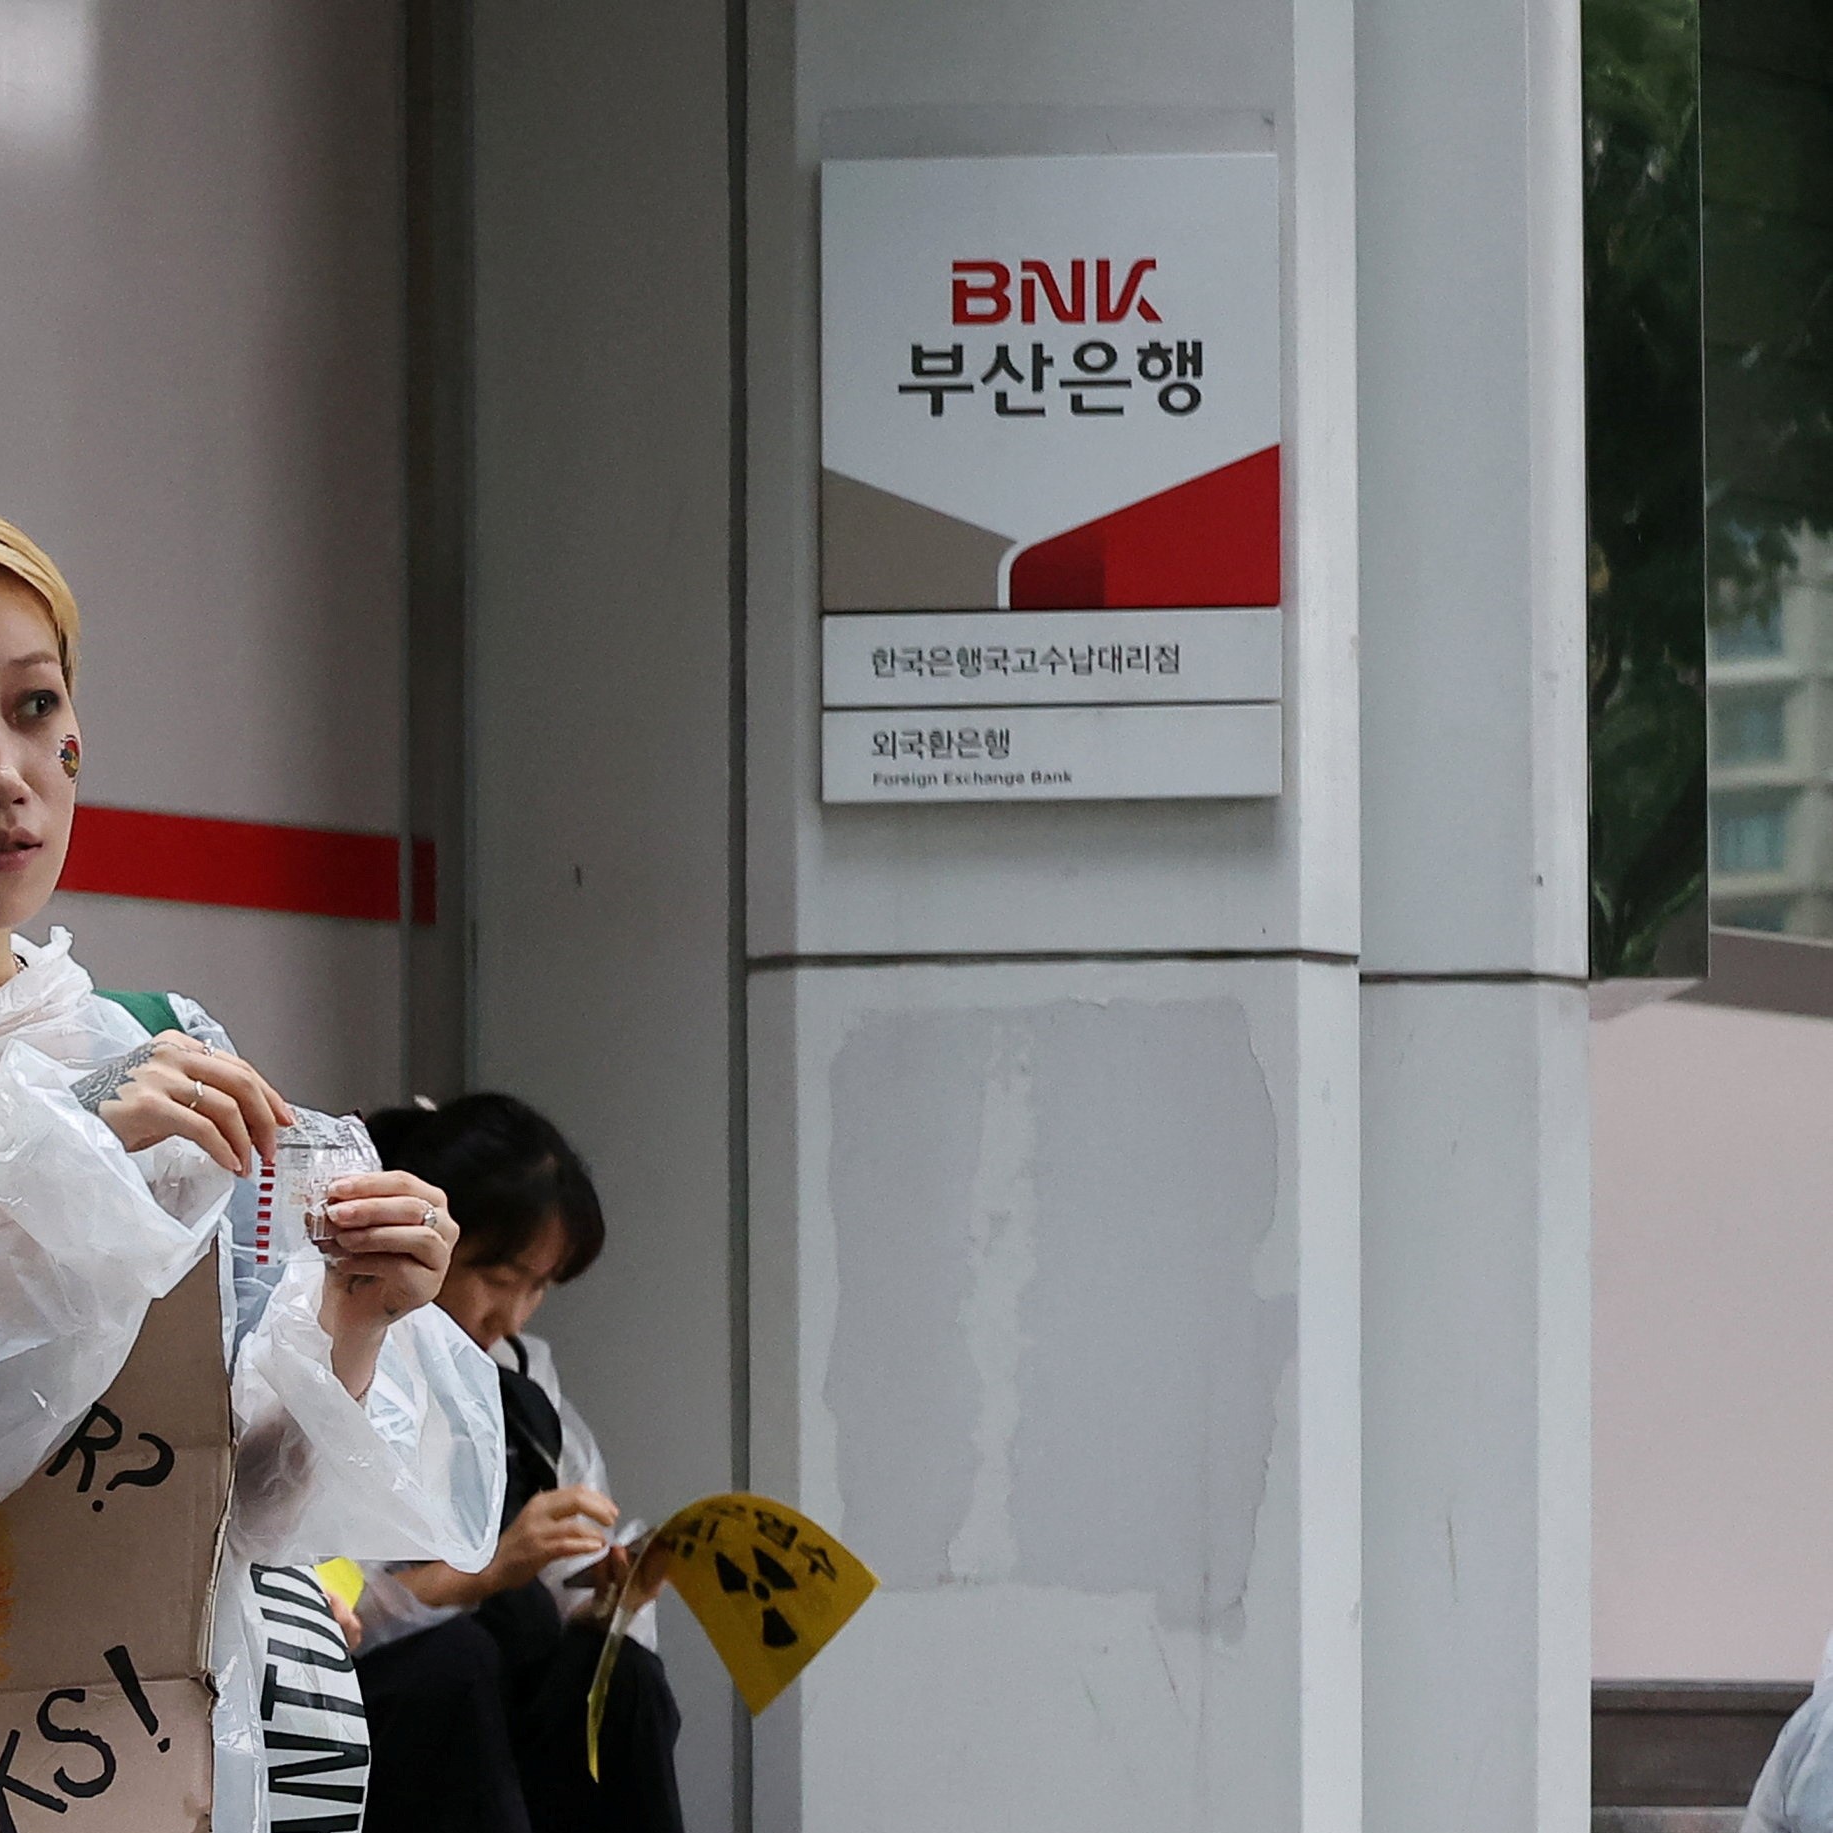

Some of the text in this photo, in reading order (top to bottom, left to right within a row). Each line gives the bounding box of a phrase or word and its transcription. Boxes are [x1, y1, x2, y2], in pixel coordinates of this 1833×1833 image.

[951, 258, 1163, 326] BNK
[897, 339, 1204, 418] 부산은행
[871, 643, 1181, 679] 한국은행국고수납대리점
[870, 727, 1012, 761] 외국환은행
[872, 769, 1074, 788] Foreign Exchange Bank
